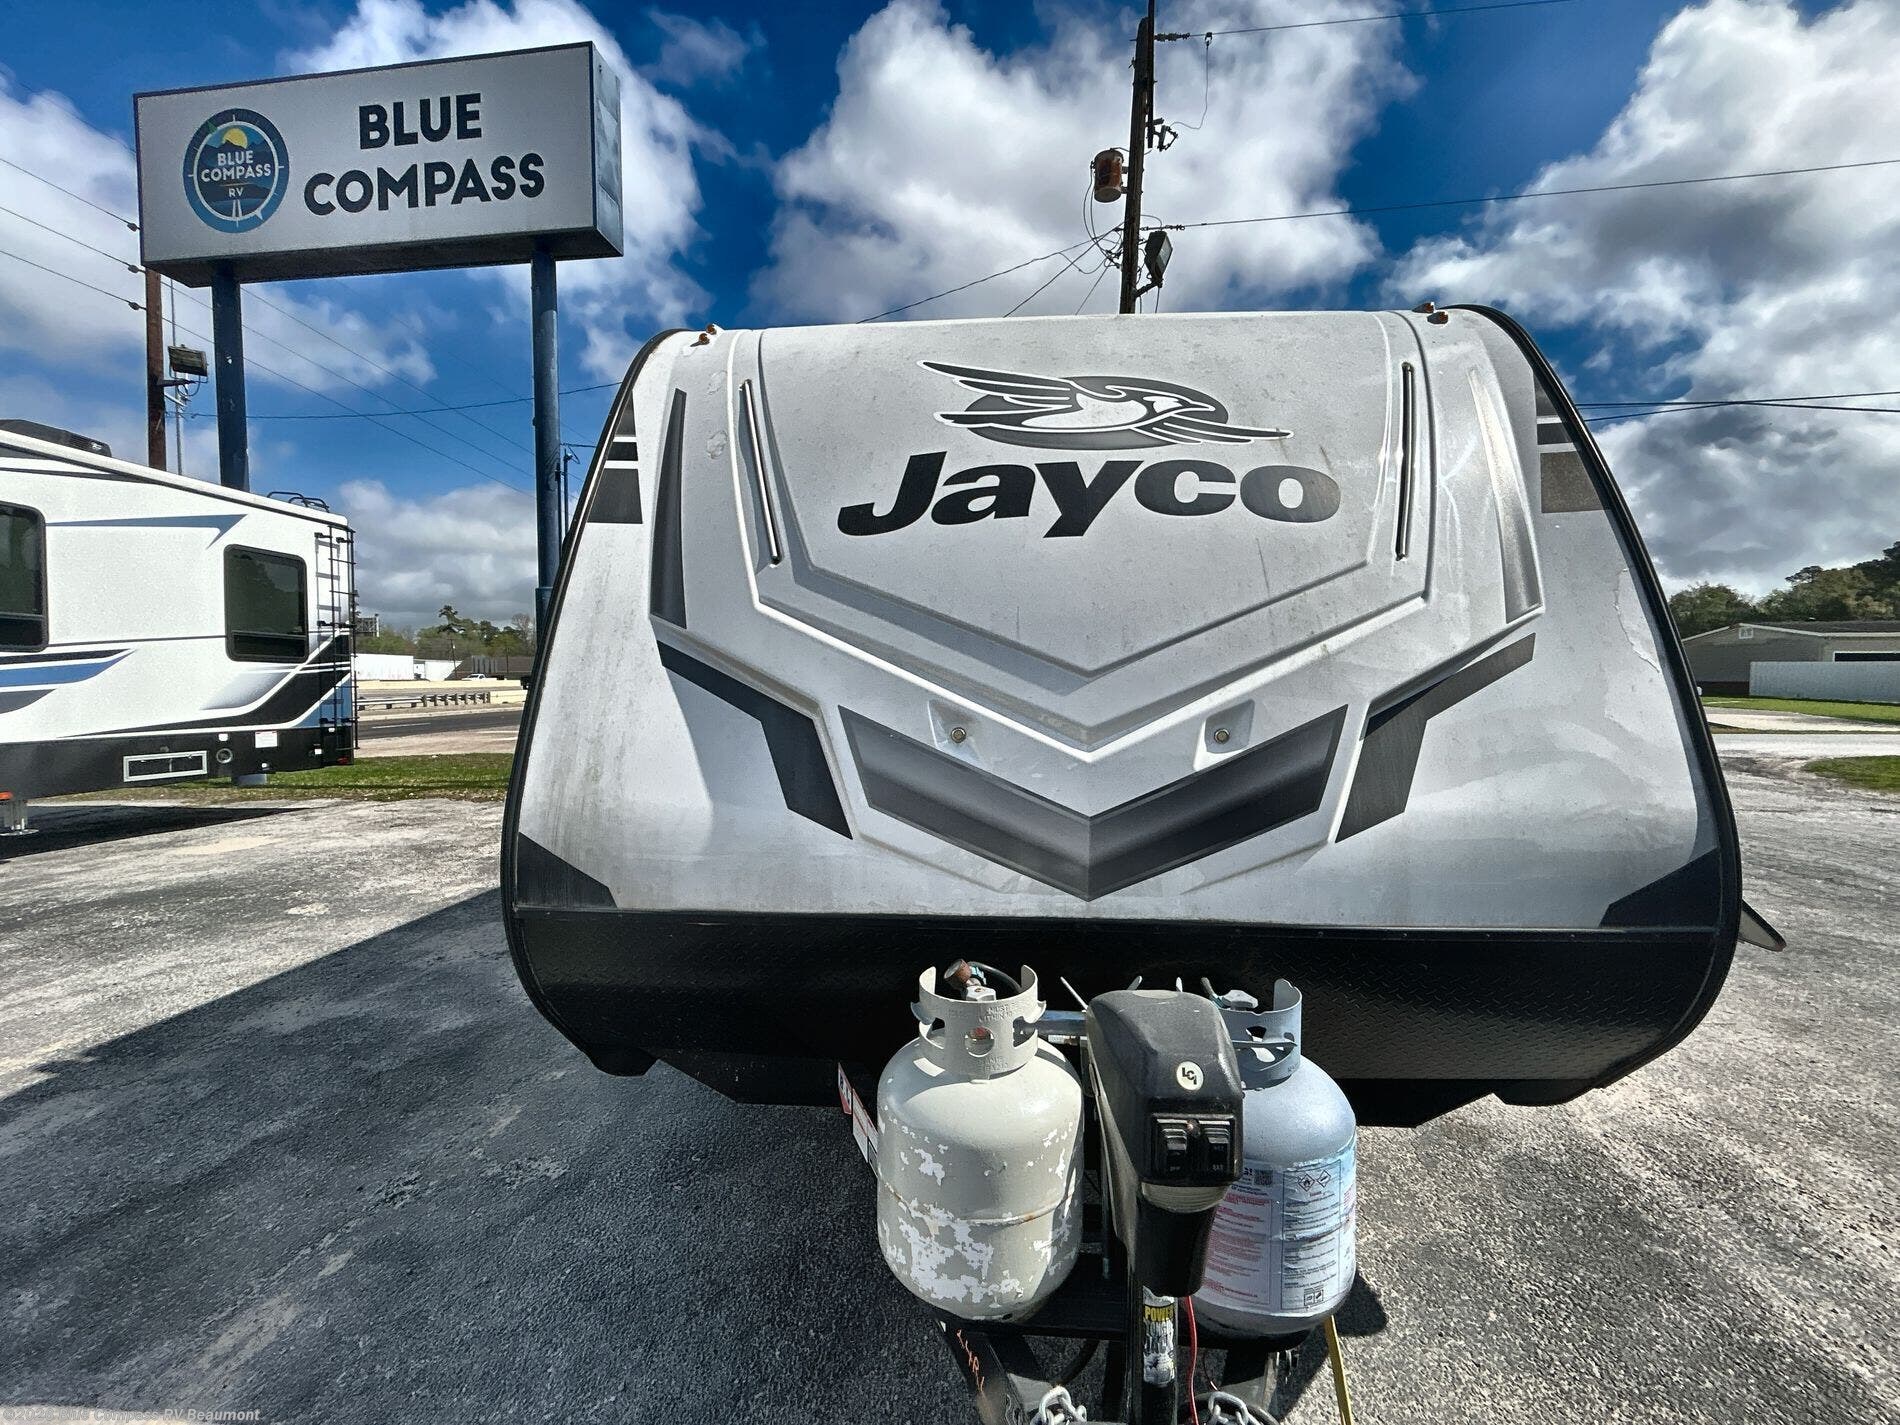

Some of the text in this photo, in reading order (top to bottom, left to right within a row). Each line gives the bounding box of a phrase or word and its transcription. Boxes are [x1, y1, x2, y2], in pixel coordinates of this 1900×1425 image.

[359, 93, 482, 149] BLUE
[201, 163, 272, 182] COMPASS
[217, 150, 254, 166] BLUE
[228, 187, 244, 198] RV
[304, 152, 545, 216] COMPASS
[837, 451, 1341, 538] Jayco
